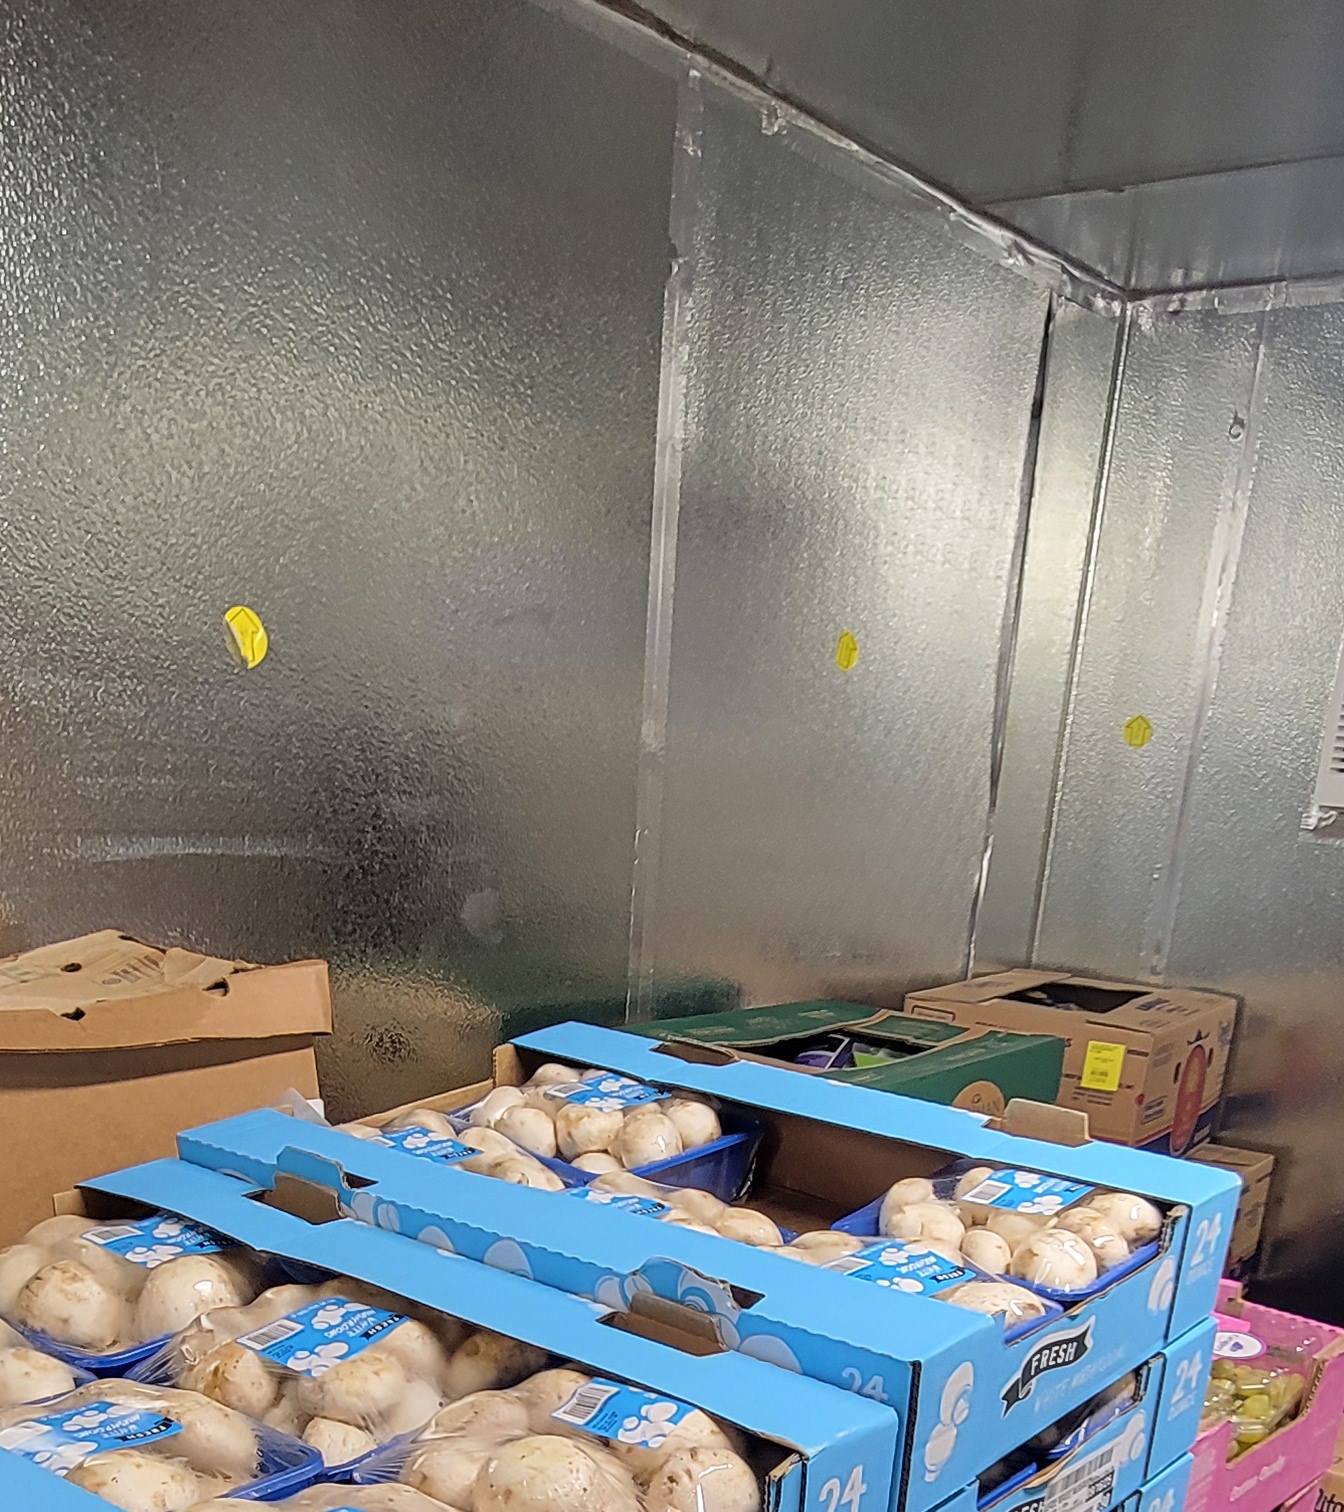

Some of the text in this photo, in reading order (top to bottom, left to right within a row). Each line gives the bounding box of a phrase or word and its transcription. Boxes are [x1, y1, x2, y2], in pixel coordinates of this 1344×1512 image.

[1190, 1213, 1222, 1268] 24
[367, 1314, 402, 1337] FRESH
[1029, 1341, 1079, 1377] FRESH
[1171, 1348, 1203, 1403] 24
[841, 1366, 889, 1401] 24
[126, 1425, 168, 1440] FRESH
